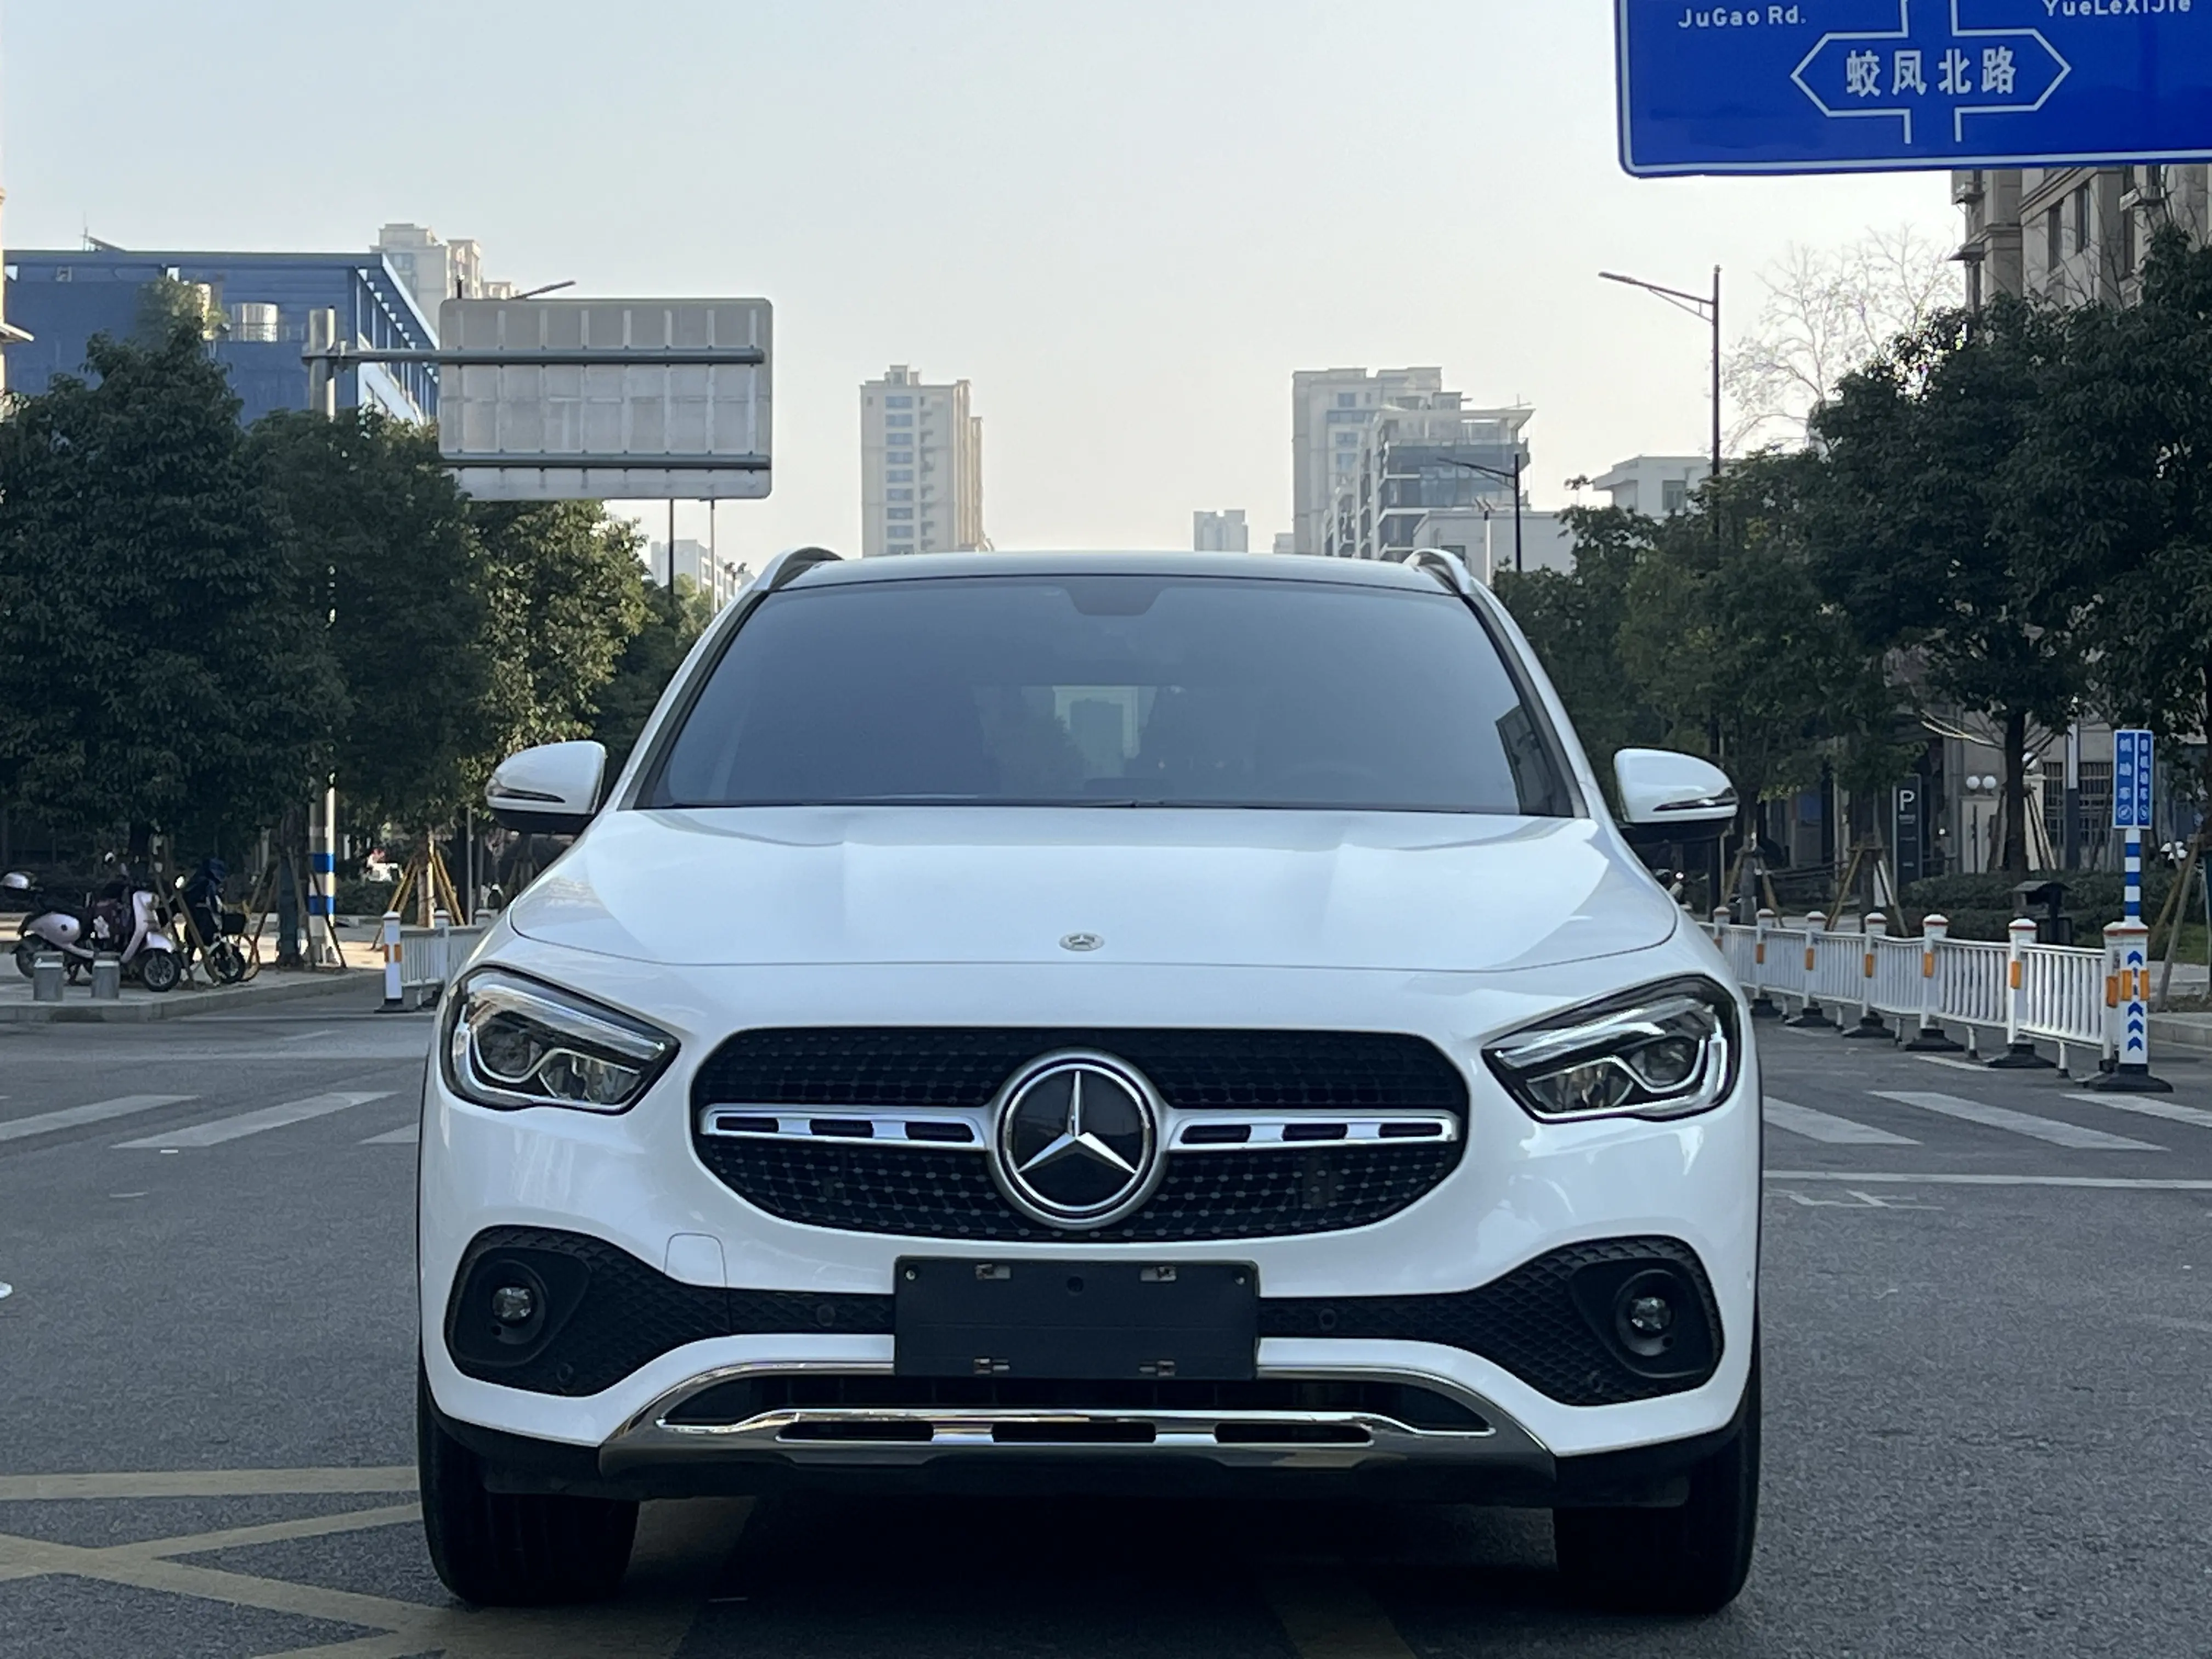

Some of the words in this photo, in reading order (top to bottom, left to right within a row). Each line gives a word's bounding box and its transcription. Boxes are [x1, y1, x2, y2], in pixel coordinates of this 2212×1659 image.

[1678, 7, 1760, 28] JuGao
[1767, 4, 1807, 25] Rd.
[1846, 46, 2017, 97] 蛟凤北路
[1900, 790, 1915, 811] P
